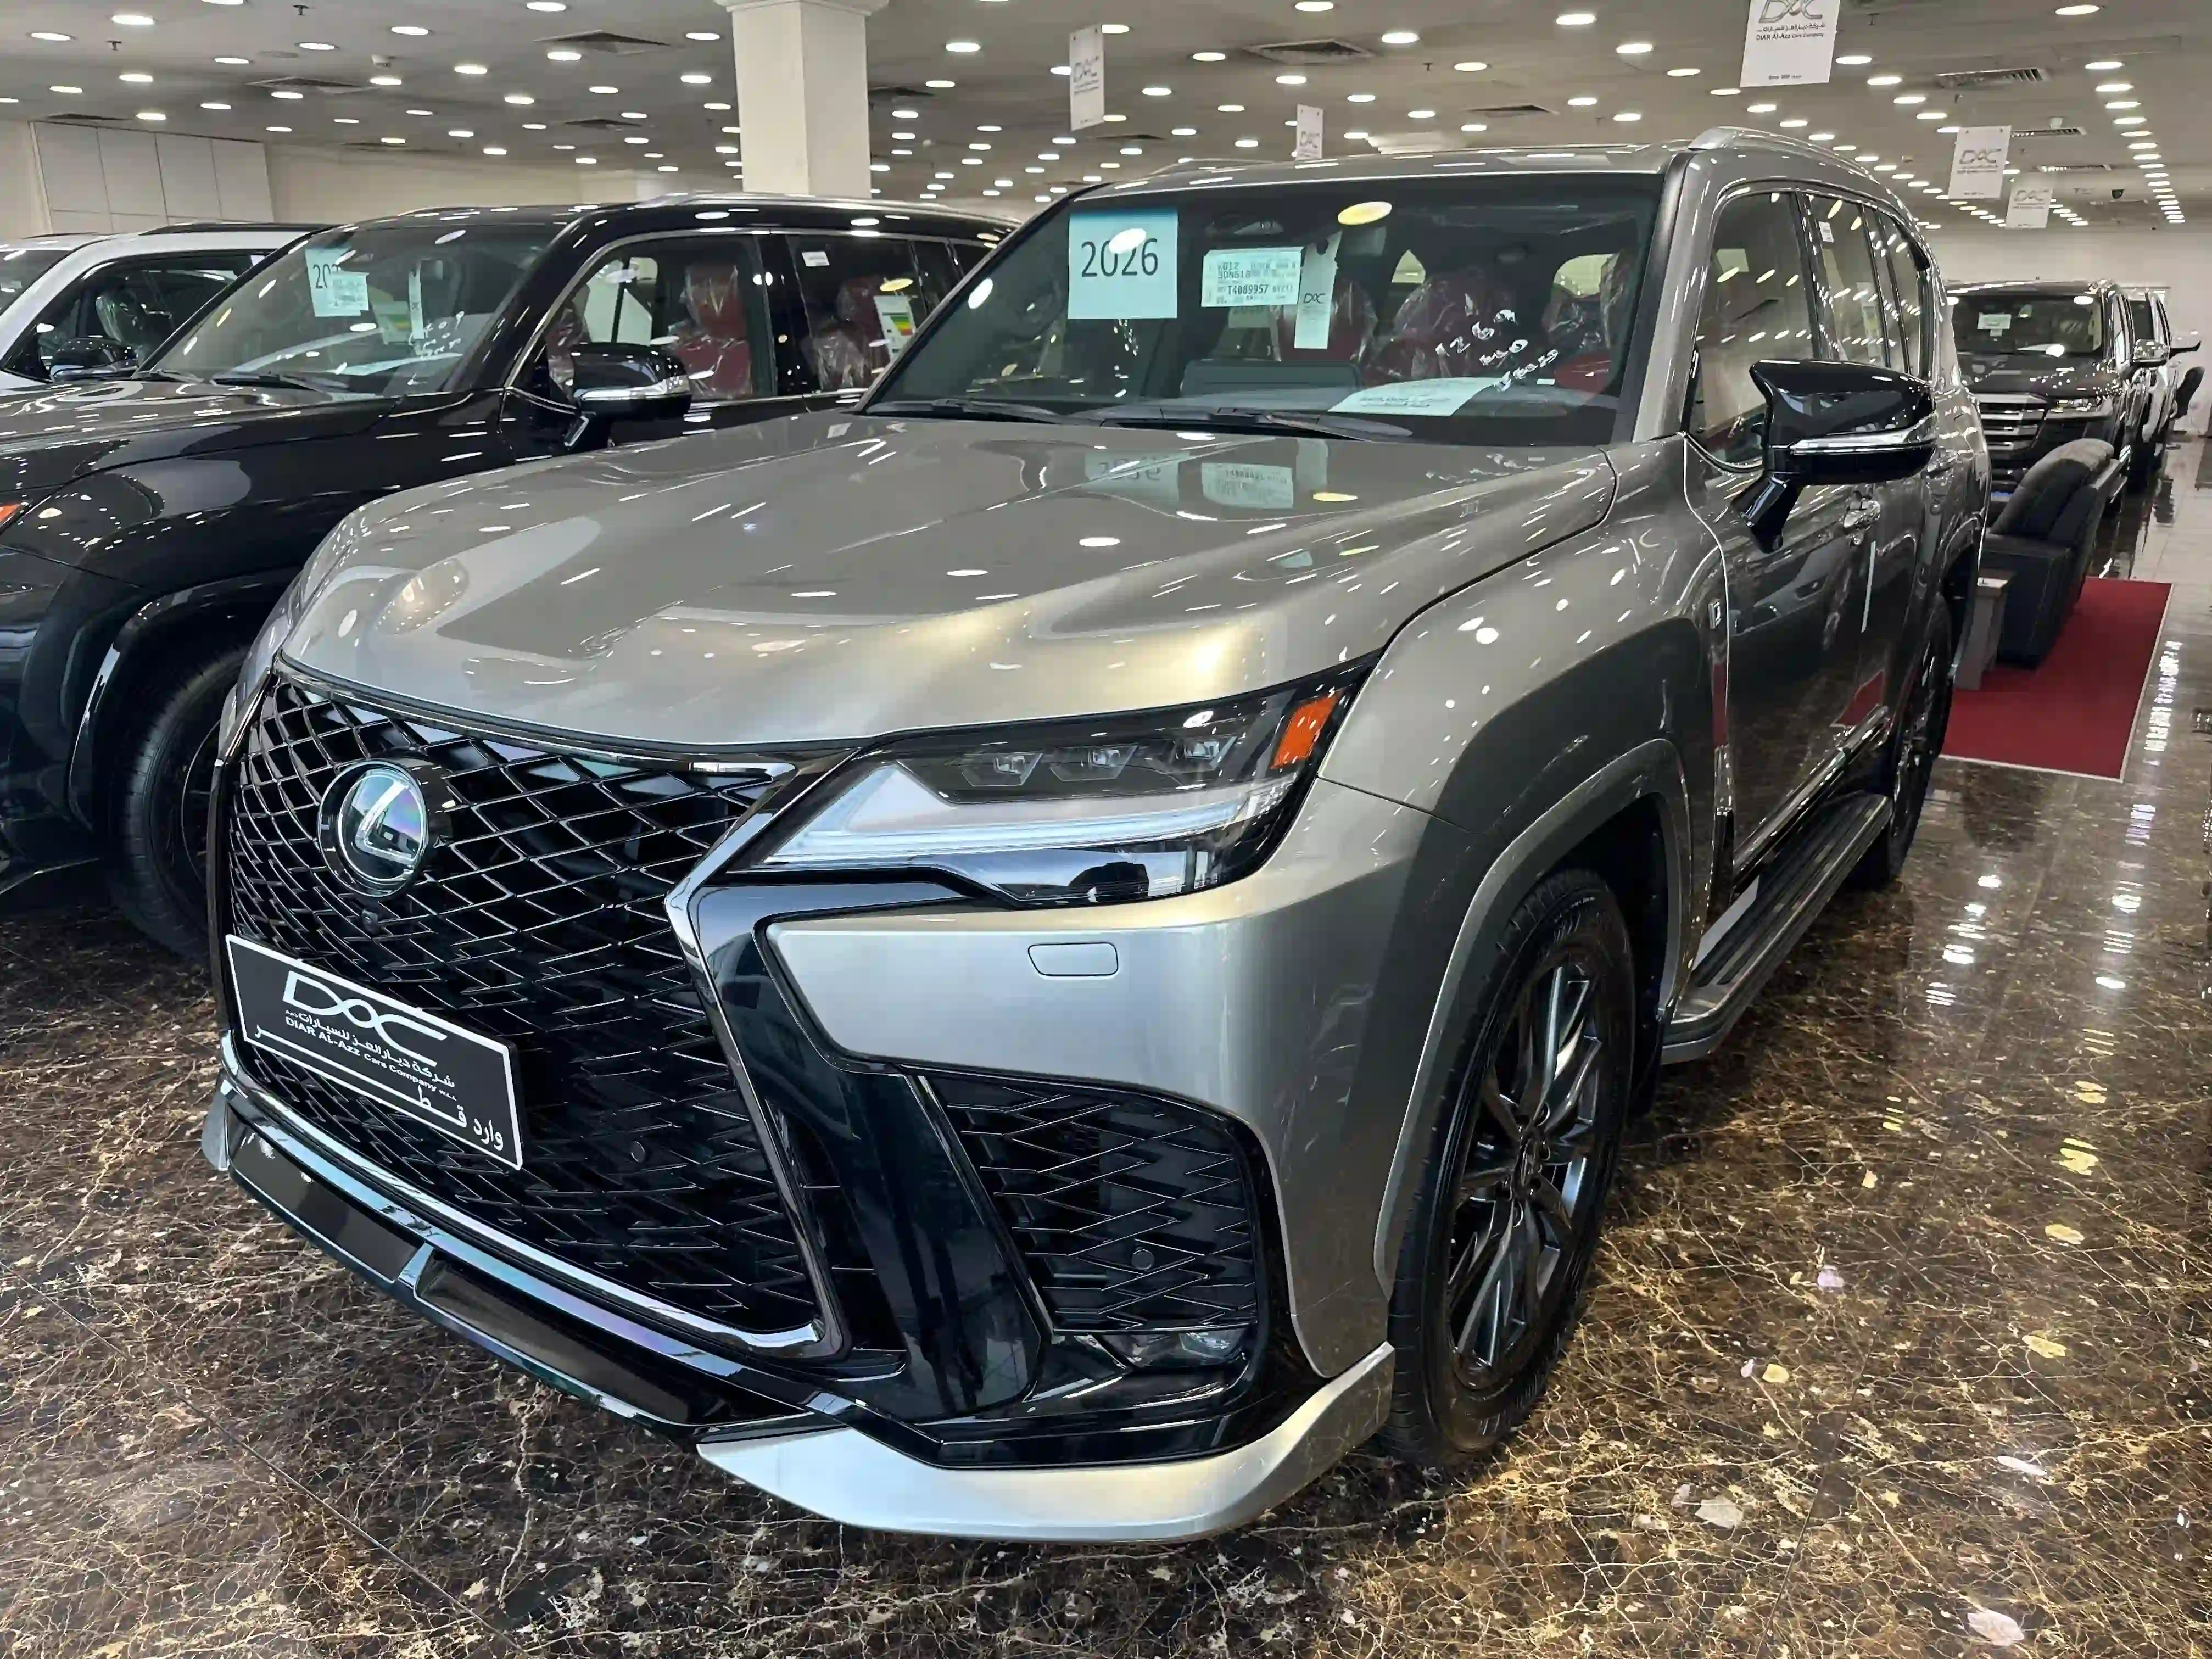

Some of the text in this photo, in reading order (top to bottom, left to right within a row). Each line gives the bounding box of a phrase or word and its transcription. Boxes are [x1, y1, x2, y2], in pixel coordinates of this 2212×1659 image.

[1081, 238, 1158, 277] 2026
[285, 1016, 317, 1037] DIAR
[364, 1053, 387, 1068] Cars
[389, 1064, 437, 1092] Company
[412, 1060, 455, 1088] شركة
[473, 1118, 504, 1152] وارد
